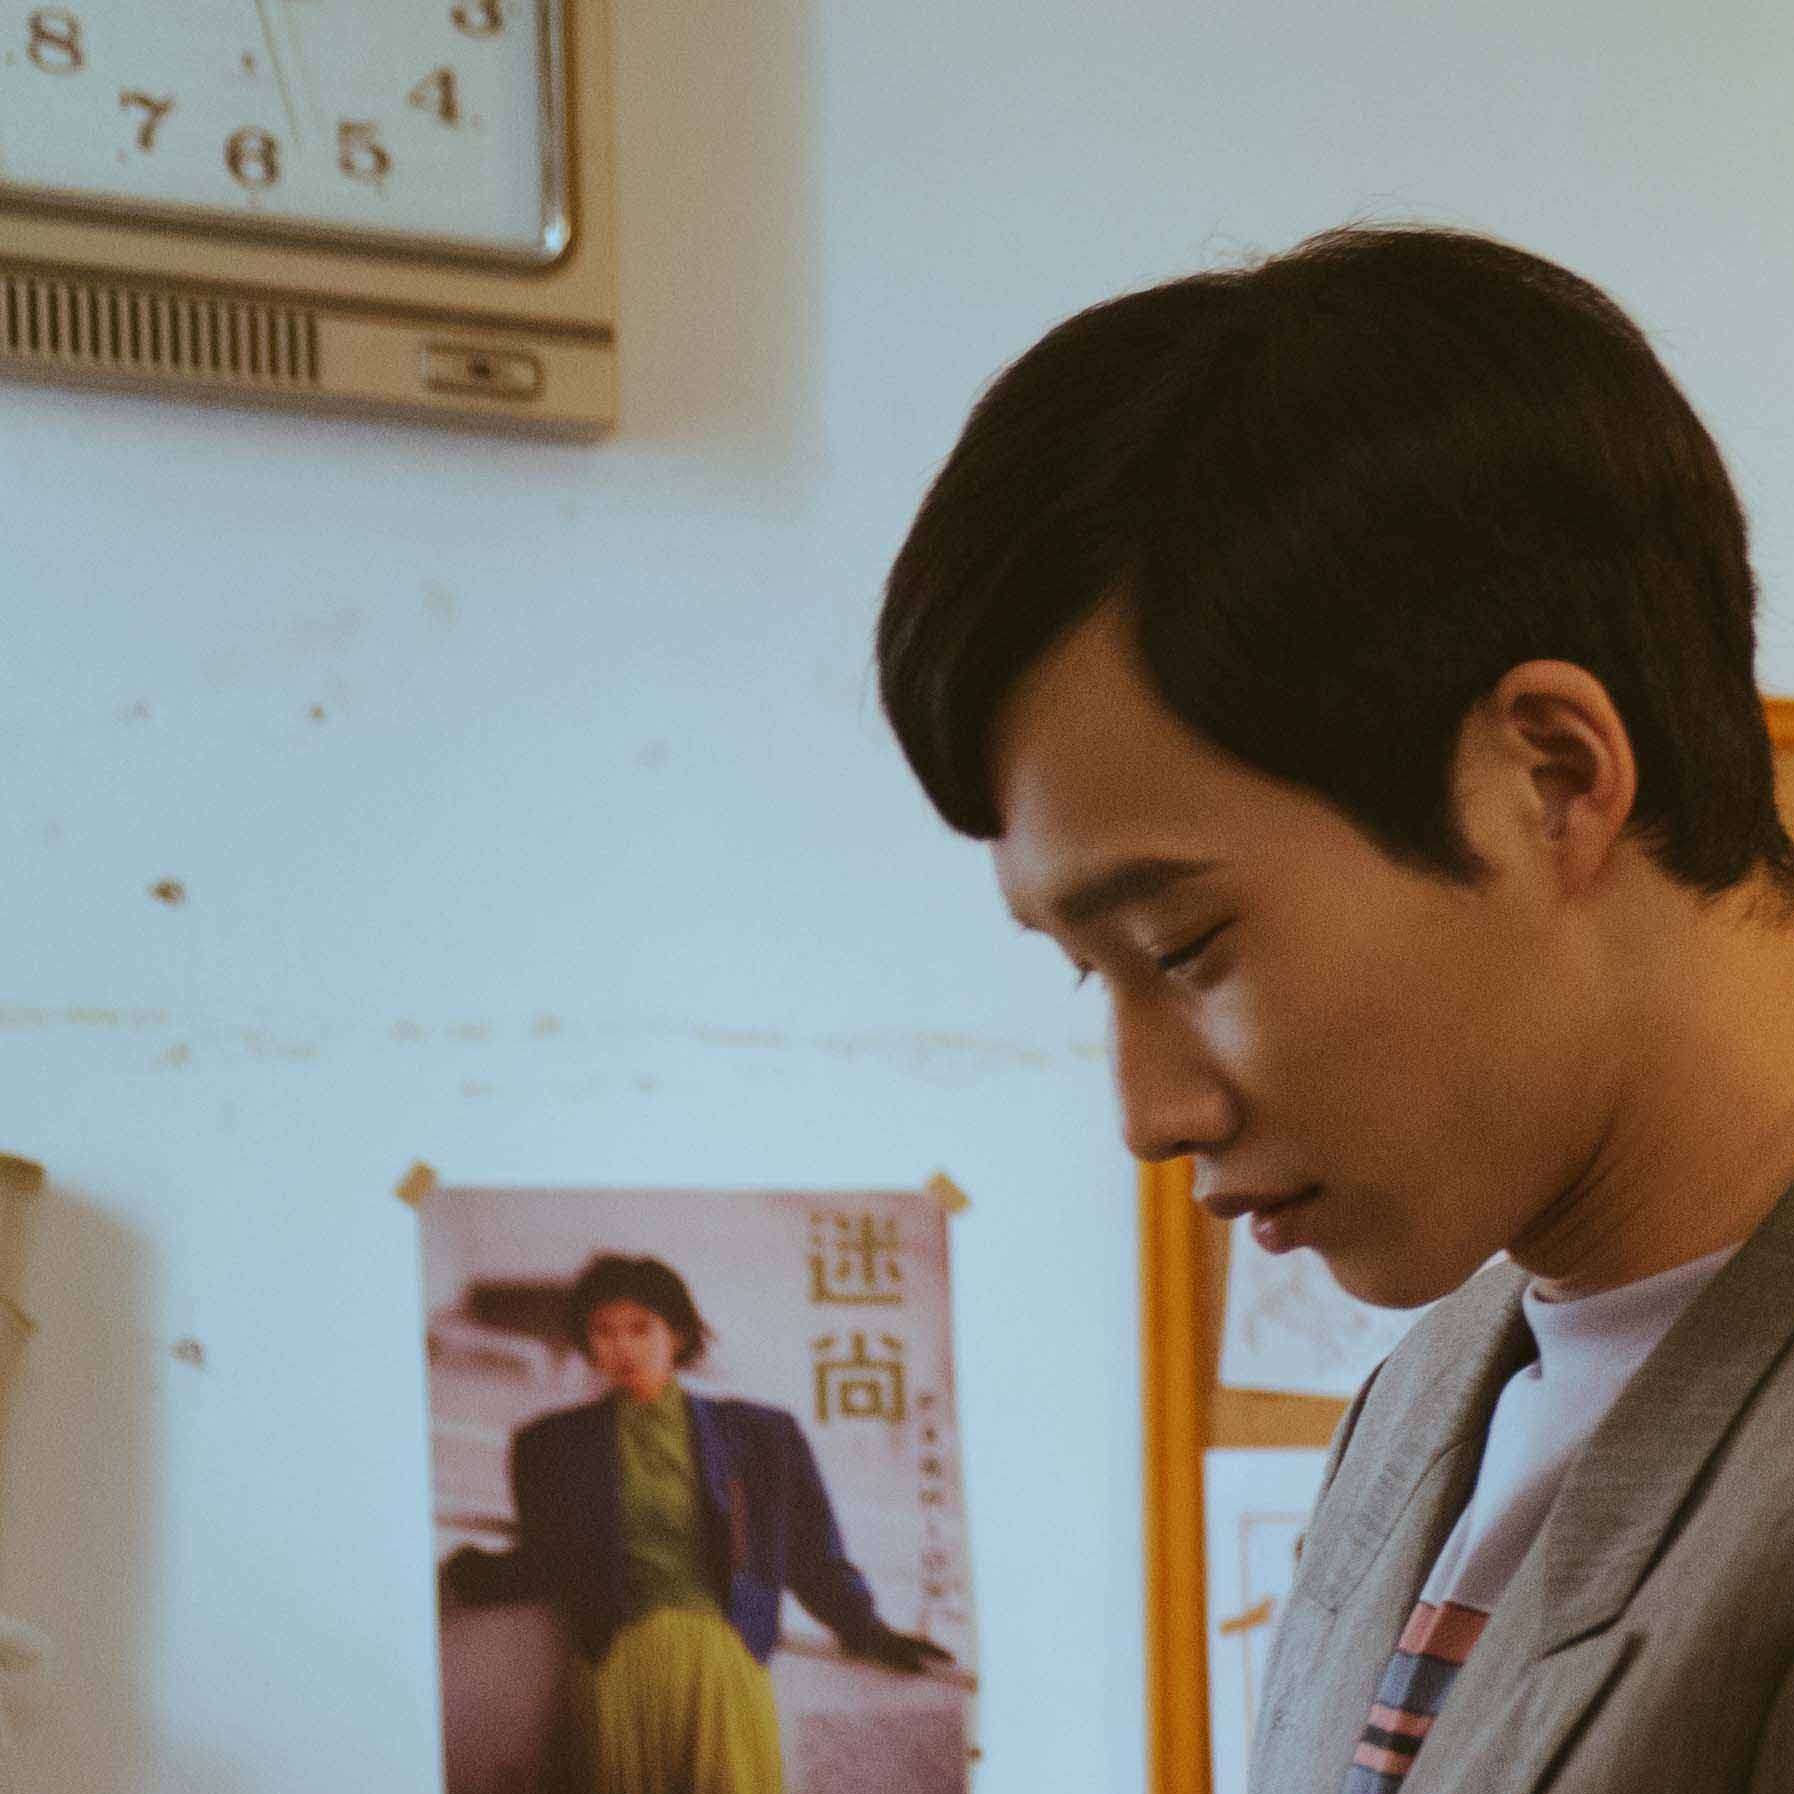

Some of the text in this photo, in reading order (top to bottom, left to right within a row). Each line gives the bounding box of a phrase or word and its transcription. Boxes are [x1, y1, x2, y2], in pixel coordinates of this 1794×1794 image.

[26, 8, 85, 74] 8
[119, 87, 174, 151] 7
[407, 66, 459, 127] 4
[225, 125, 280, 189] 6
[337, 119, 392, 181] 5
